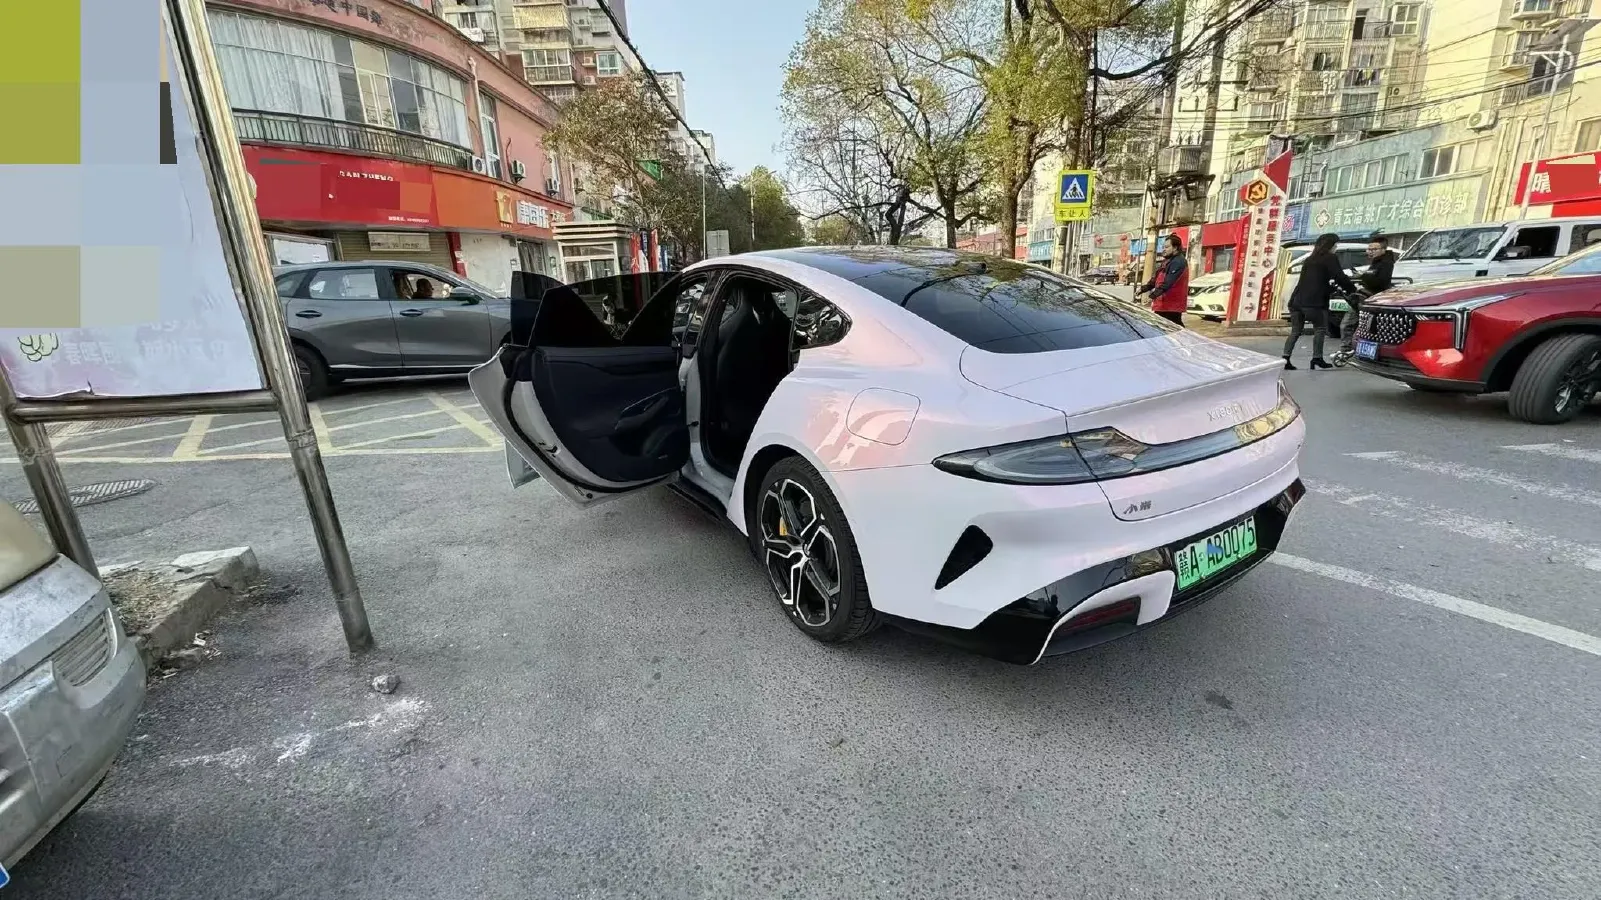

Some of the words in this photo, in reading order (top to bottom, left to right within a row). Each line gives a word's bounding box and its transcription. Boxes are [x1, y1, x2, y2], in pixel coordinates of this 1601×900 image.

[1059, 209, 1086, 218] 车让人
[1261, 194, 1282, 268] 党群服务中心
[1123, 500, 1152, 515] 小米
